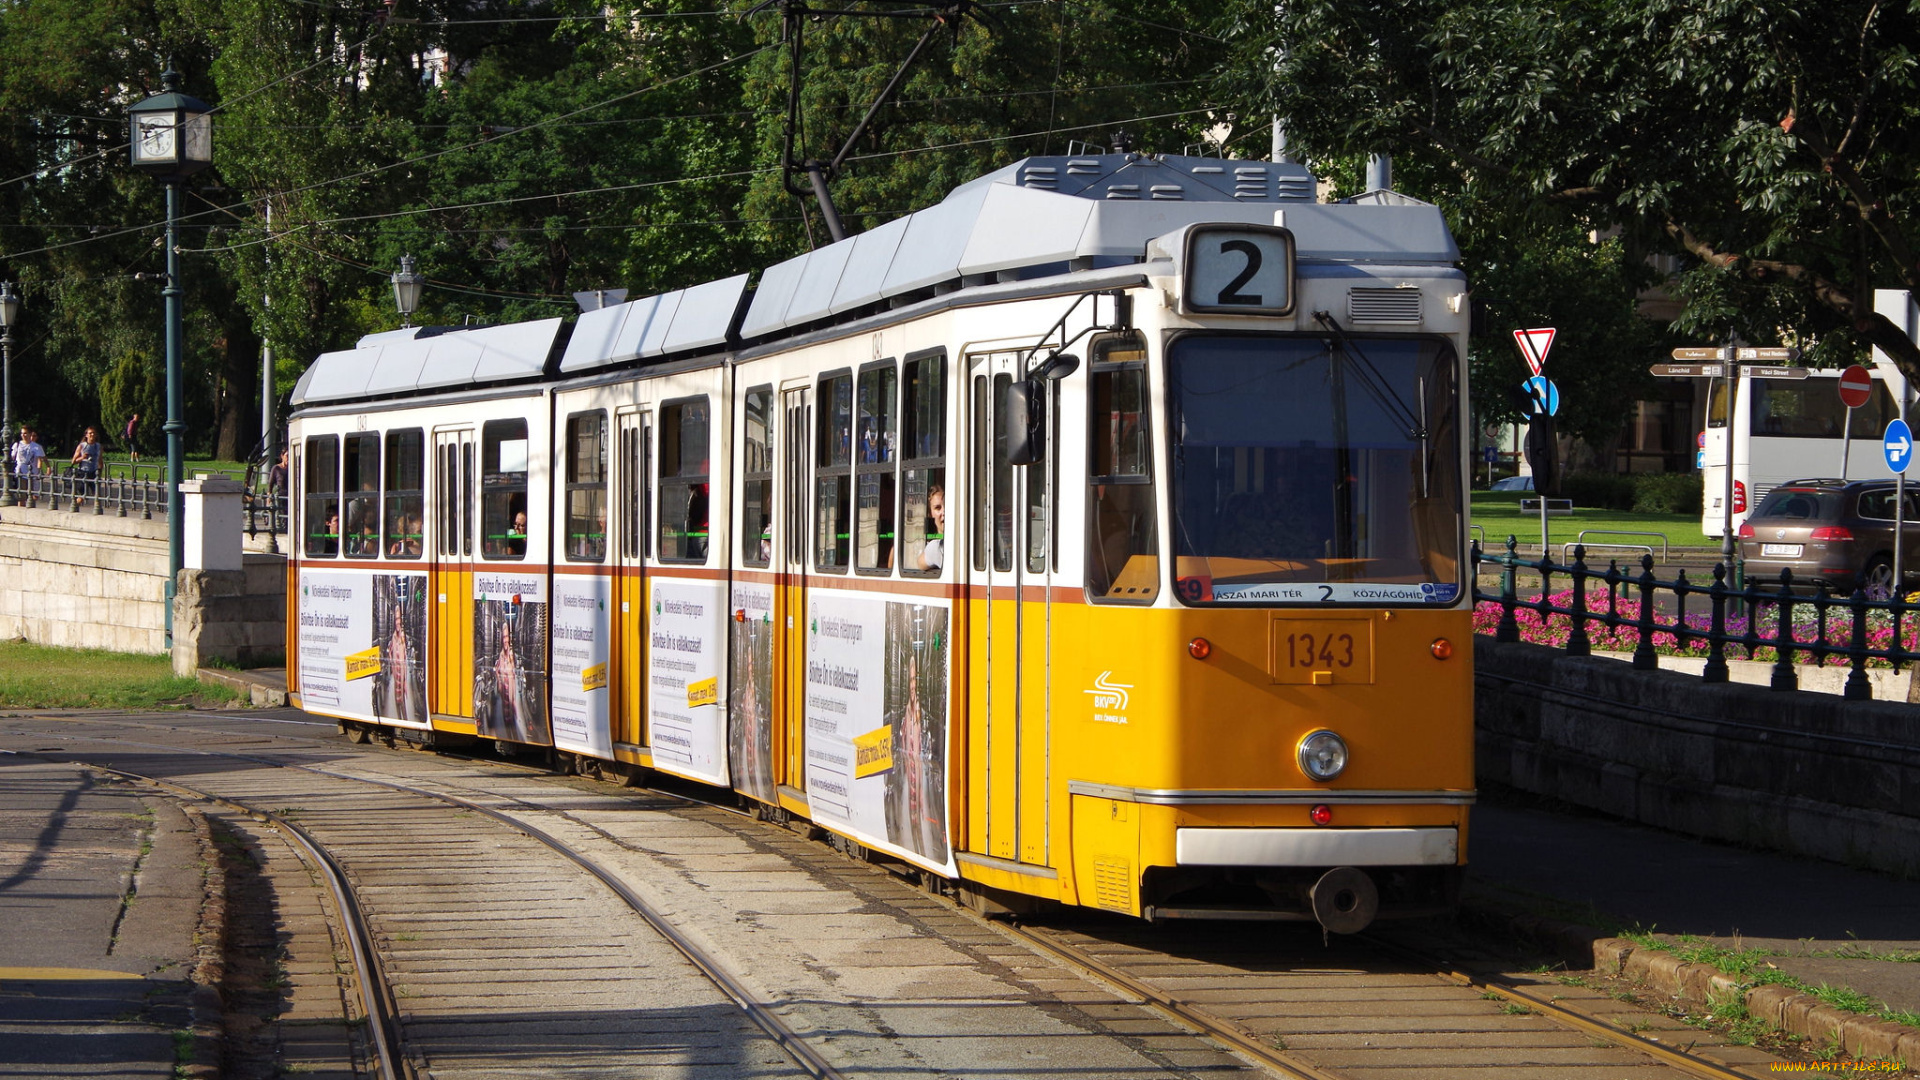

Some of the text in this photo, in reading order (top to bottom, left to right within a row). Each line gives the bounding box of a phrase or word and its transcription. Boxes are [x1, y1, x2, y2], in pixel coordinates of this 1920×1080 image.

[1217, 239, 1263, 305] 2
[1250, 591, 1279, 599] MARI
[1282, 590, 1303, 598] TÉR
[1318, 586, 1336, 602] 2
[1353, 590, 1423, 600] KÖZVÁGÓHÍD
[1287, 633, 1354, 668] 1343
[1095, 696, 1109, 709] BKV
